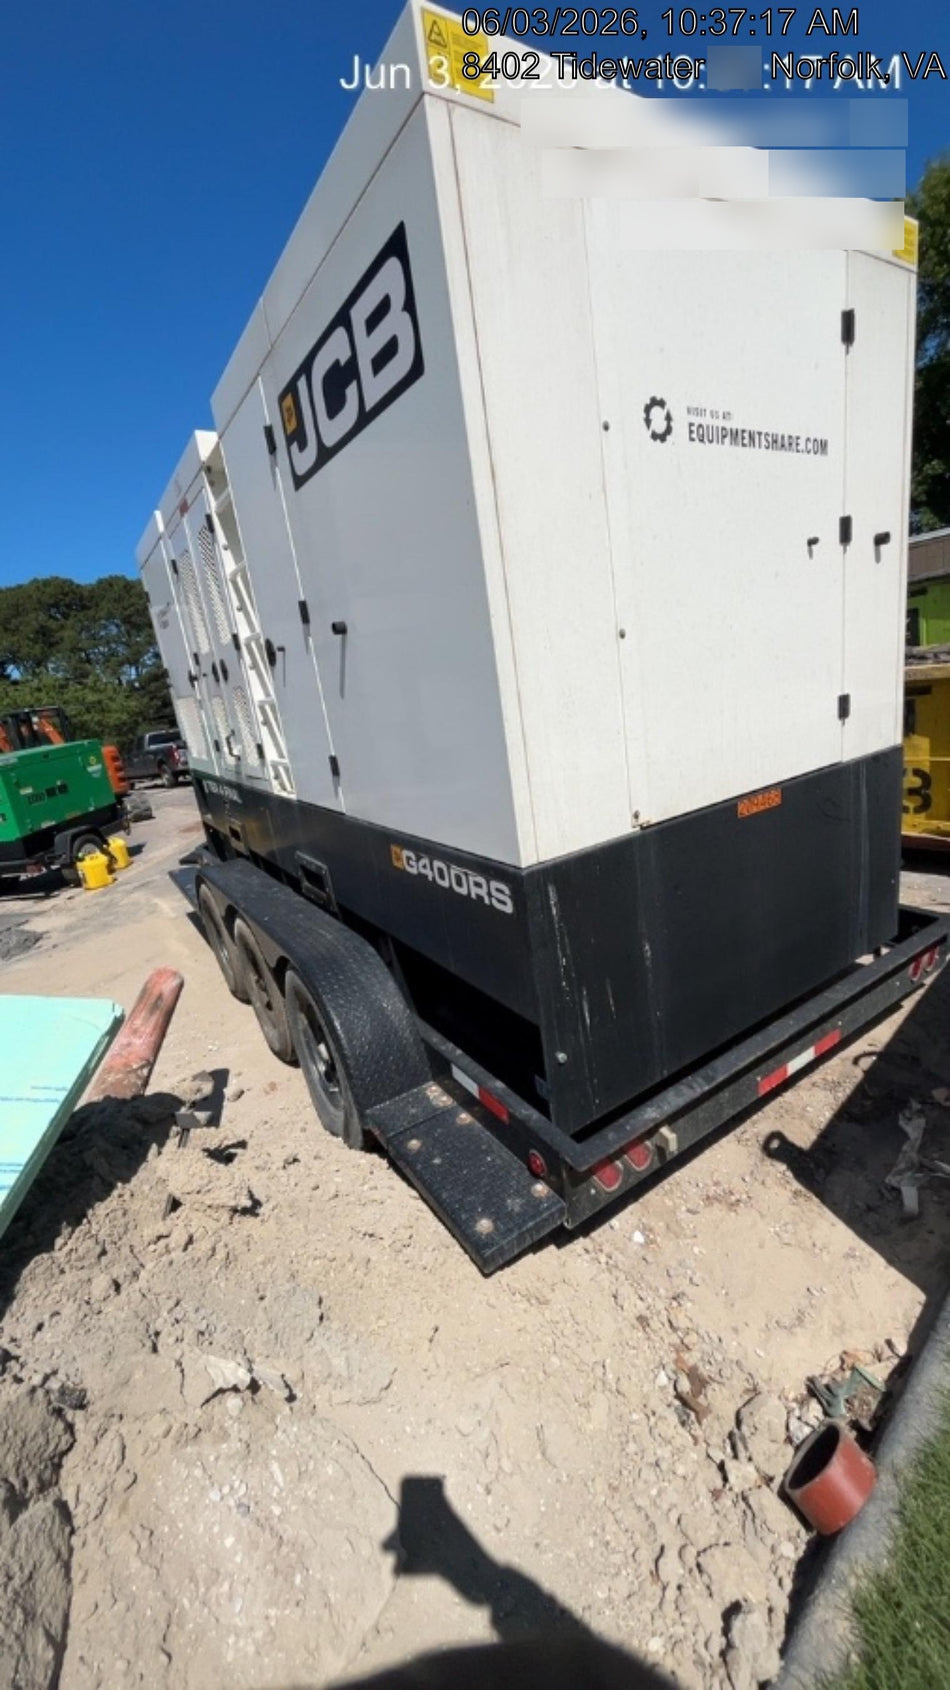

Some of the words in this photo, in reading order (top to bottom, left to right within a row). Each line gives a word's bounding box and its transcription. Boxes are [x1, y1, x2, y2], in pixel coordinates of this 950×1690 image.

[289, 255, 416, 477] JCB
[688, 422, 829, 456] EQUIPMENTSHARE.COM
[402, 849, 514, 914] G400RS
